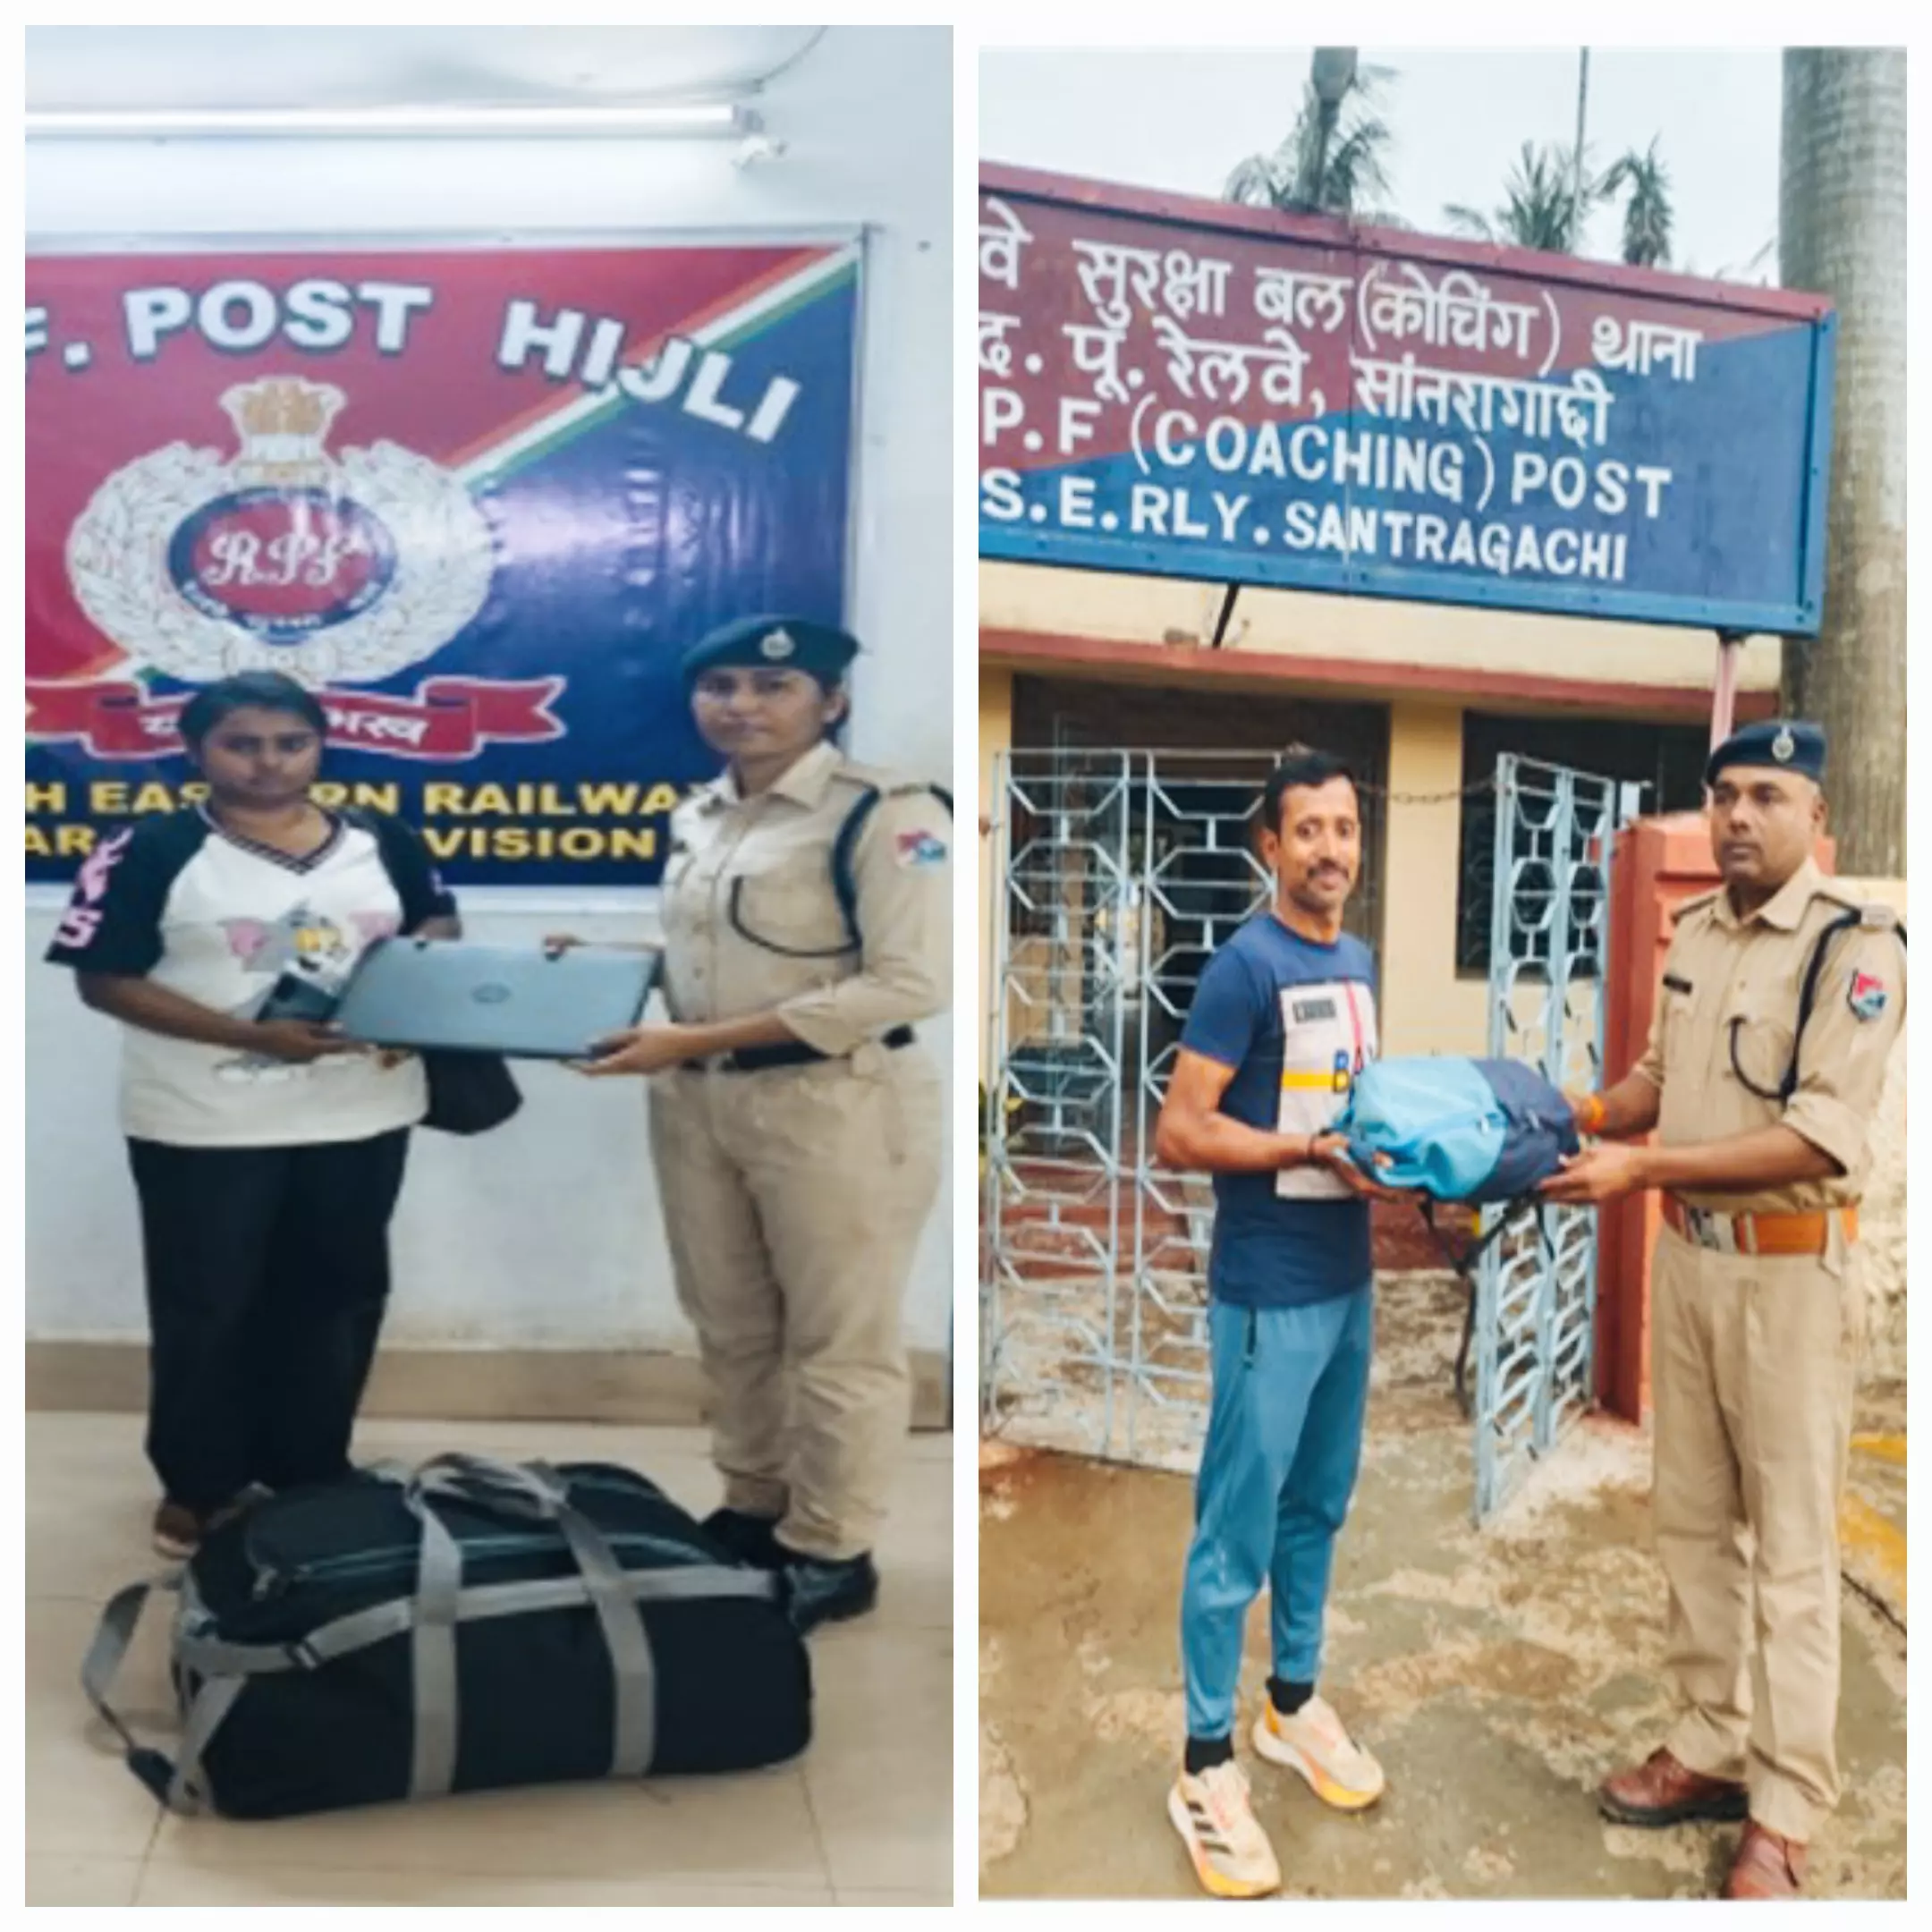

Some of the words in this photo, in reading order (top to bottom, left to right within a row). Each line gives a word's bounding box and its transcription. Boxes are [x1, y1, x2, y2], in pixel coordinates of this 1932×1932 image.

[123, 278, 432, 355] POST
[495, 300, 799, 445] HIJLI
[1072, 238, 1233, 329] सुरक्षा
[1256, 267, 1353, 335] बल
[1592, 314, 1703, 380] थाना
[1283, 501, 1628, 581] SANTRAGACHI
[1512, 452, 1673, 519] POST
